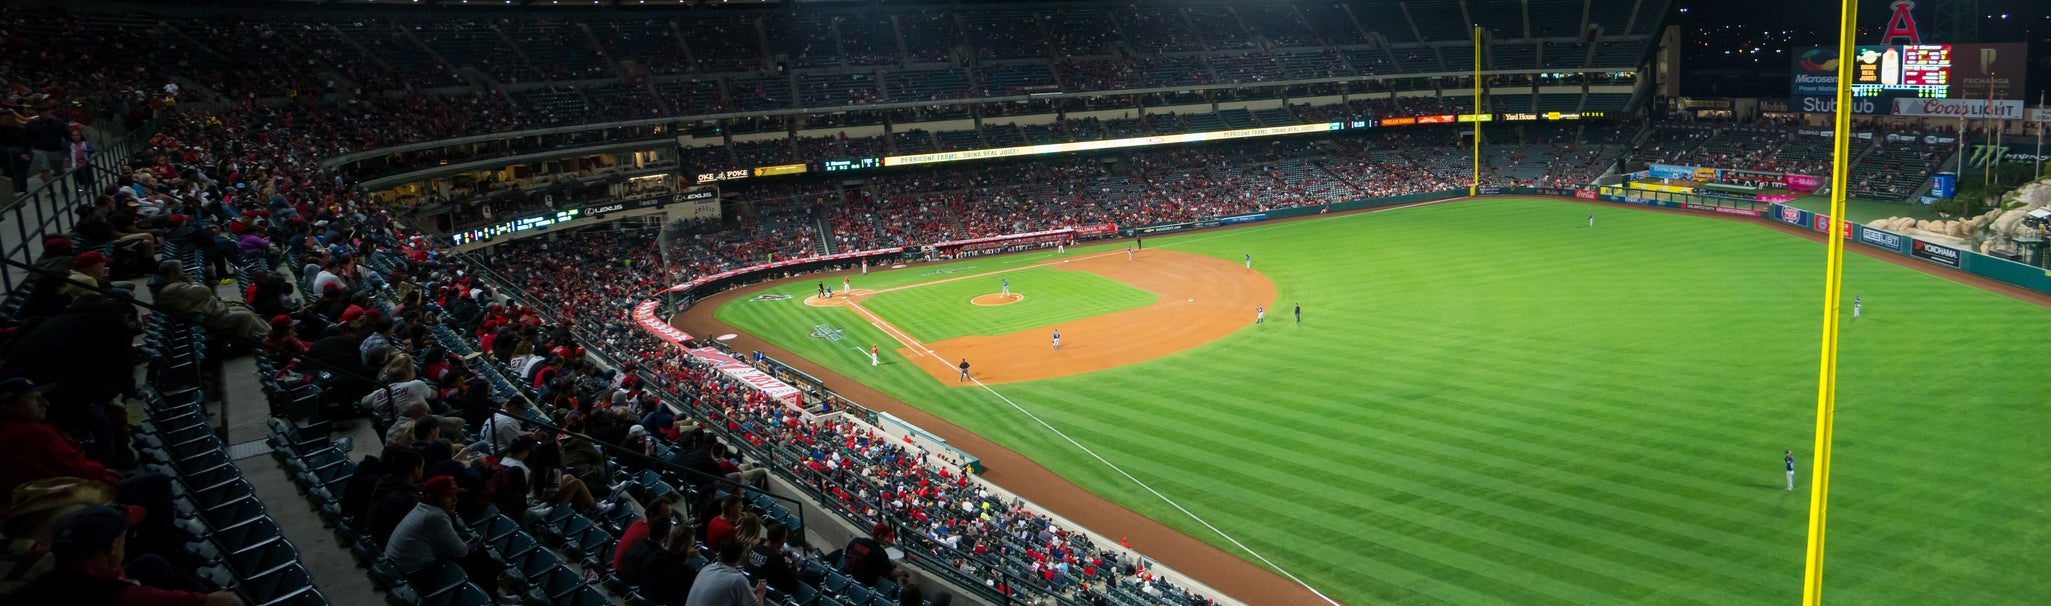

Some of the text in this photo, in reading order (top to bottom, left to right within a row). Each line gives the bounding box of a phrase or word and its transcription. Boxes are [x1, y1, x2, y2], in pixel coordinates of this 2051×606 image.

[1760, 100, 1788, 112] Modelo
[1923, 99, 1969, 115] Coors
[698, 173, 714, 181] OKE
[594, 191, 712, 214] LEXUS LEXUS
[1923, 243, 1957, 258] YOKOHAMA
[742, 373, 786, 389] 2017
